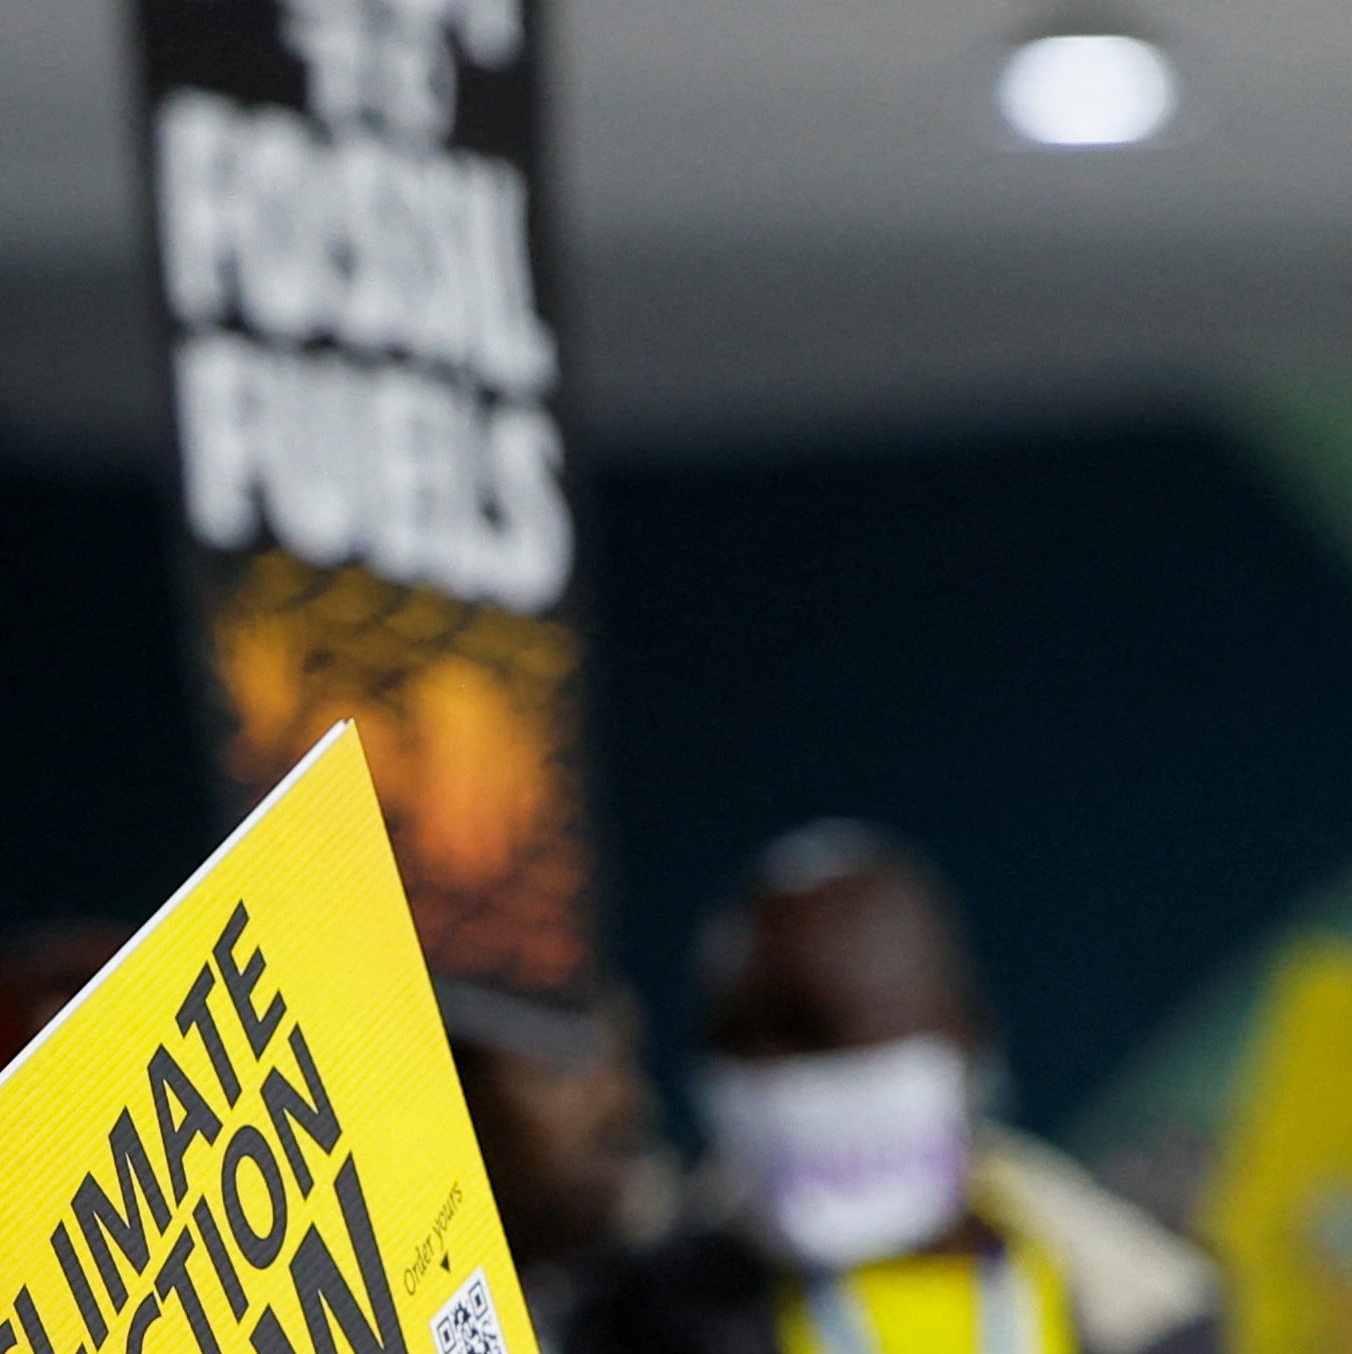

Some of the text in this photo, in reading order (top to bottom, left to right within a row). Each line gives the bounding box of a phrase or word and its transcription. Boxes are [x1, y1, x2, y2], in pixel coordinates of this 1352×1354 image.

[157, 90, 555, 394] FOSSIL
[175, 333, 572, 612] FUELS
[404, 1181, 463, 1296] Order yours
